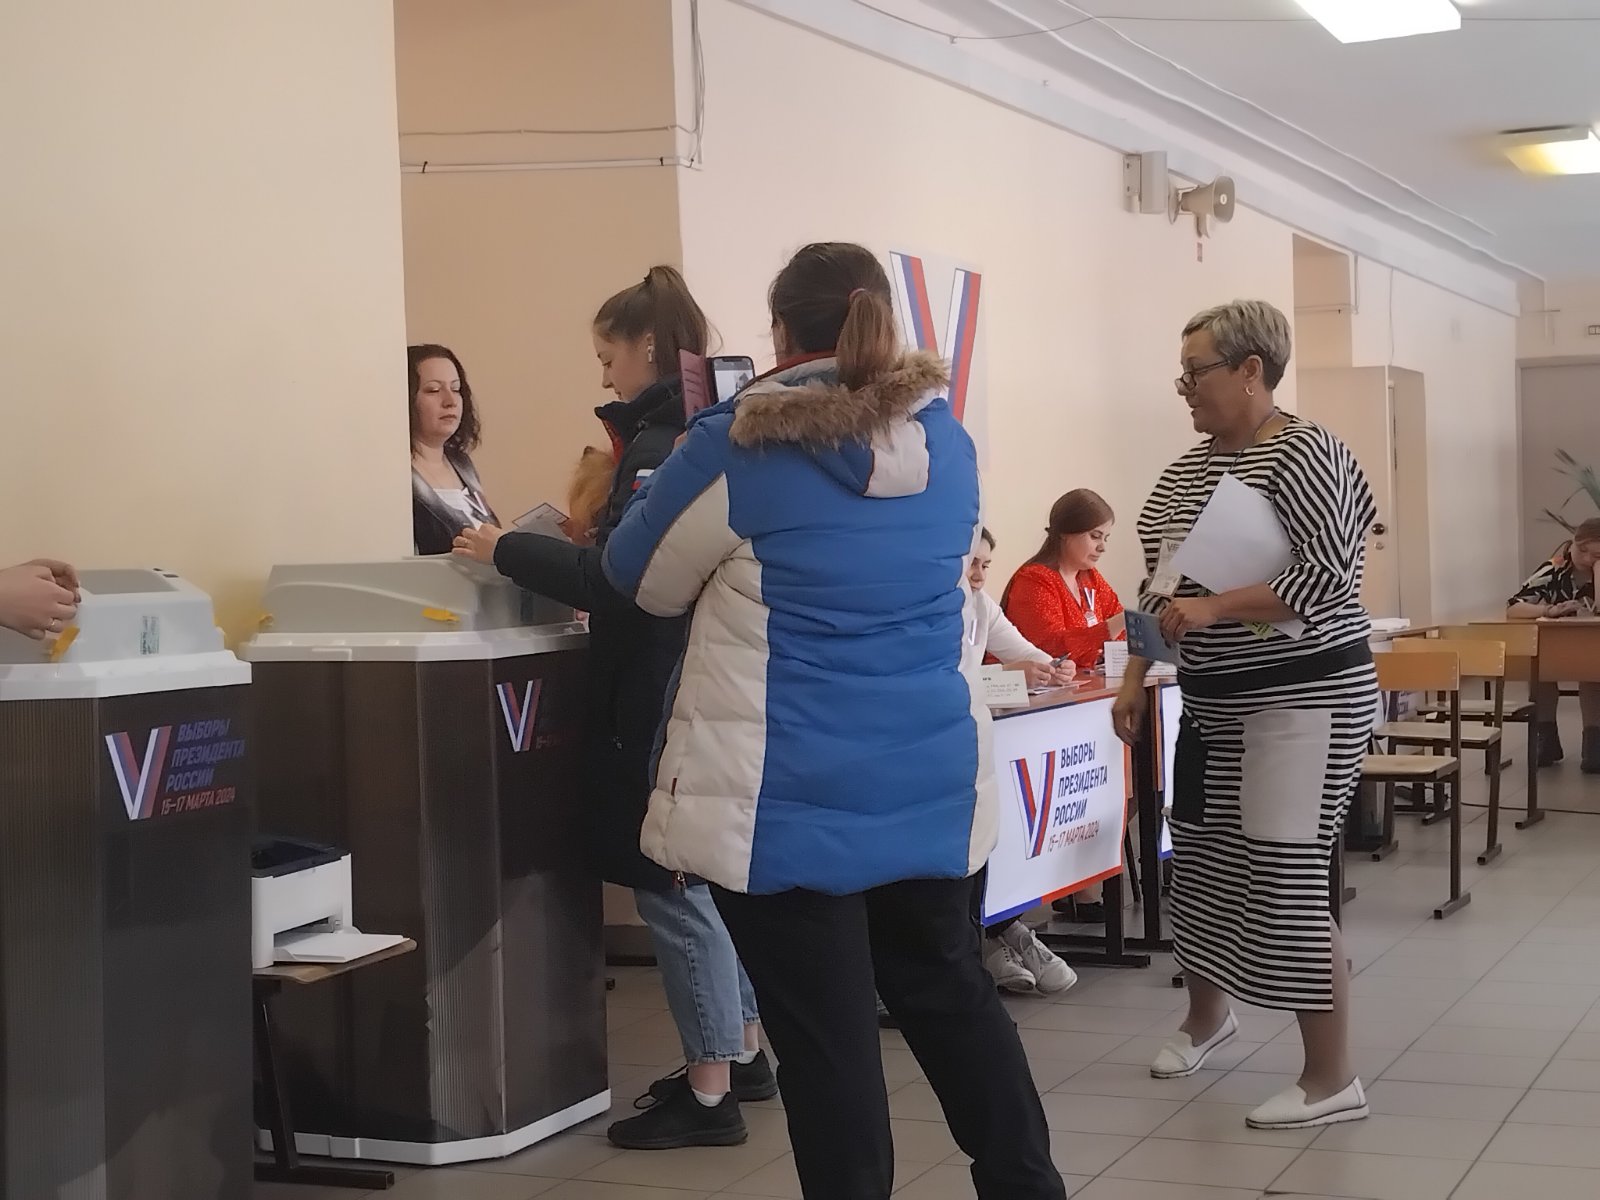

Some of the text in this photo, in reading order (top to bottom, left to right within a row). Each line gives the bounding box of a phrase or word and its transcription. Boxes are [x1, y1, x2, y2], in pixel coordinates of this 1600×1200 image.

[178, 719, 230, 741] ВЫБОРЫ
[172, 740, 245, 767] ПРЕЗИДЕНТА
[1060, 741, 1096, 769] ВЫБОРЫ
[166, 768, 214, 792] РОССИИ
[1057, 765, 1108, 798] ПРЕЗИДЕНТА
[161, 797, 186, 815] 15–17
[186, 791, 215, 810] МАРТА
[1052, 798, 1088, 828] РОССИИ
[1065, 825, 1086, 846] МАРТА
